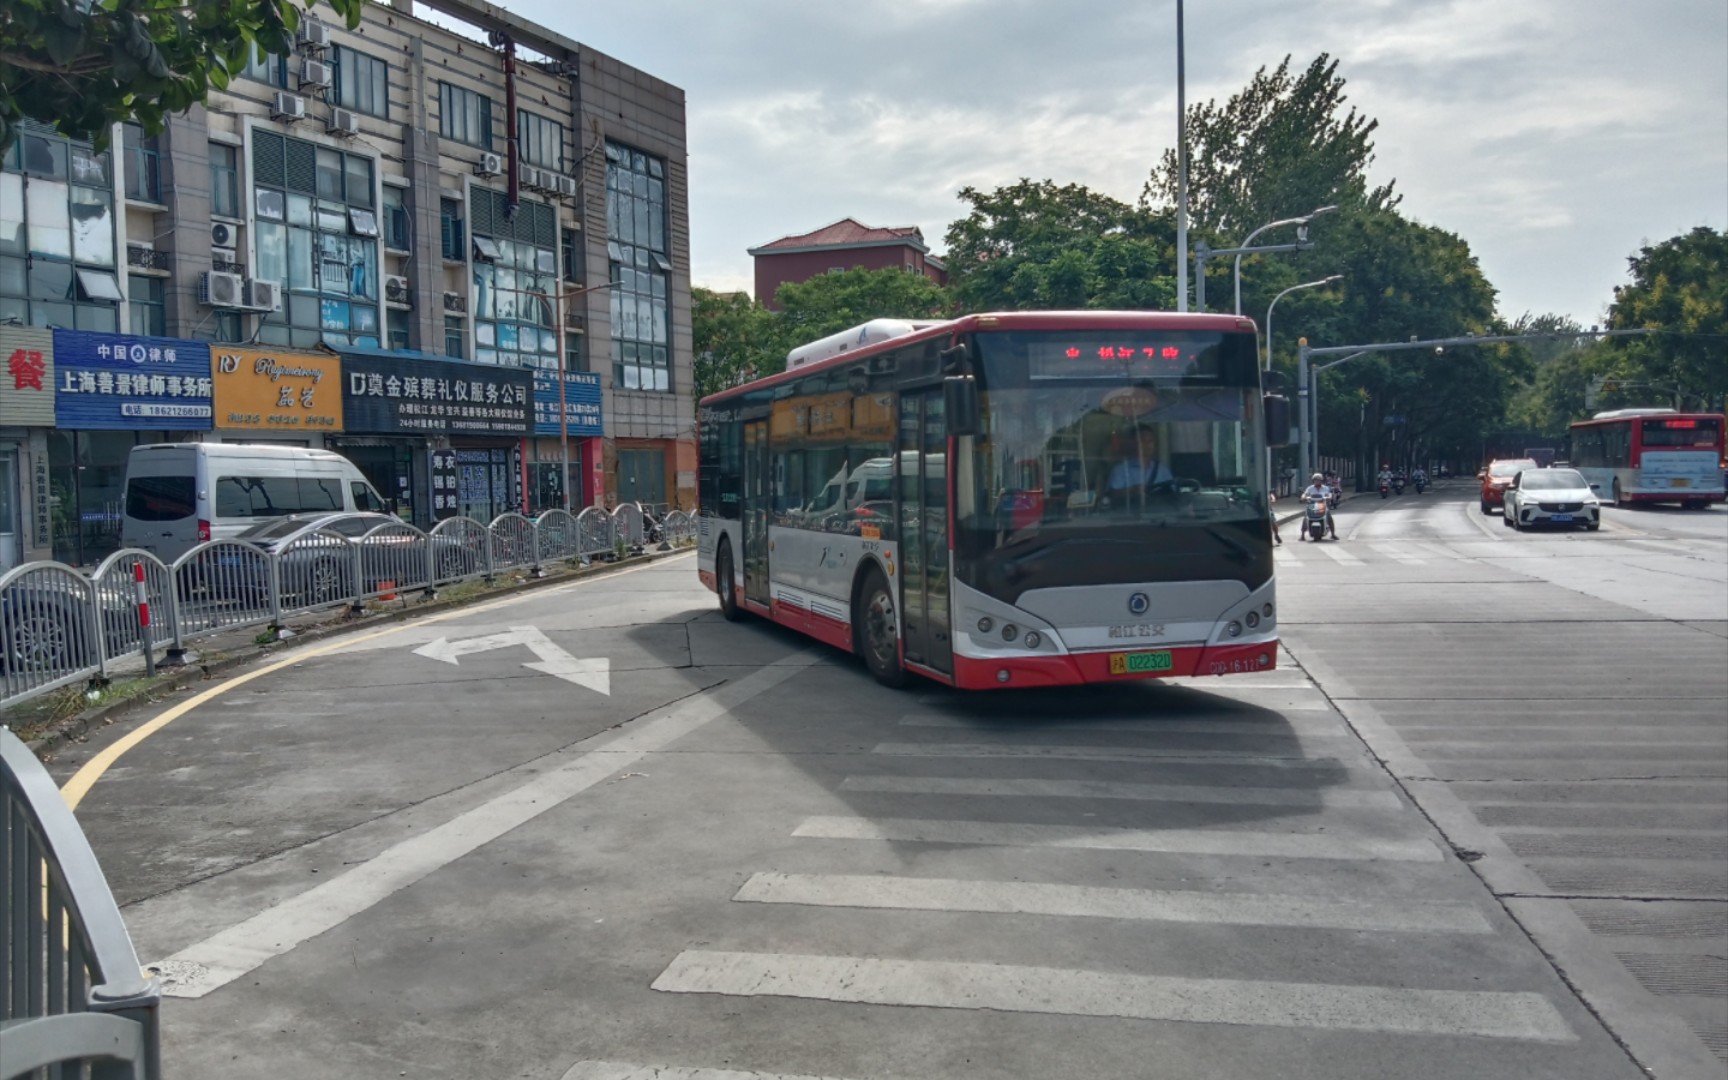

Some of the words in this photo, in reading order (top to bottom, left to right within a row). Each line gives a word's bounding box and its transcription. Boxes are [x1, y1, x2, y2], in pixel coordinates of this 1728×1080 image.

[97, 343, 127, 360] 中国
[148, 346, 176, 363] 律师
[8, 348, 46, 391] 餐
[59, 370, 212, 398] 上海善景律师事务所
[367, 372, 527, 405] 奠金殡葬礼仪服务公司
